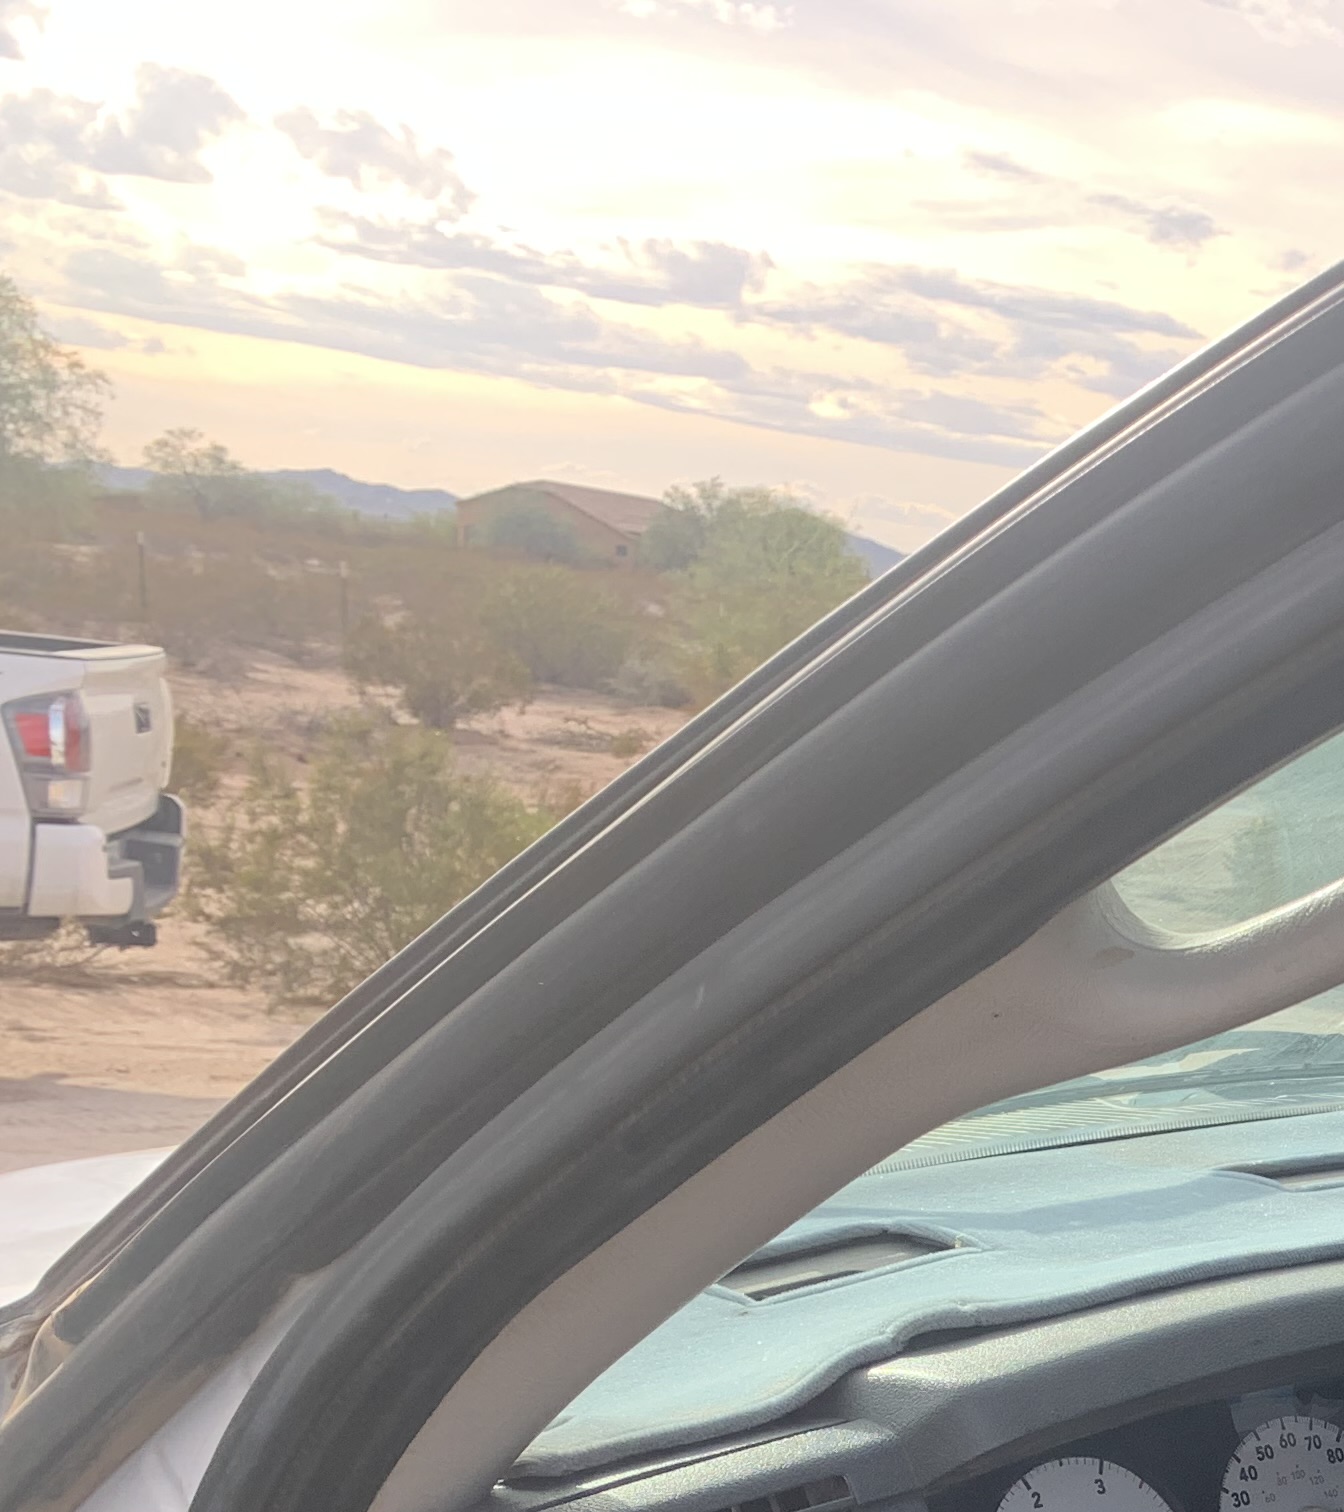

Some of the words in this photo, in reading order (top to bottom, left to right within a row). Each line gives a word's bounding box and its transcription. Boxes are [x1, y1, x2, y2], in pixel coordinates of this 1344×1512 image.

[1279, 1432, 1297, 1449] 60
[1304, 1434, 1322, 1451] 70
[1255, 1444, 1275, 1461] 50
[1326, 1447, 1344, 1464] 80
[1239, 1465, 1258, 1482] 40
[1093, 1478, 1106, 1495] 3
[1030, 1491, 1044, 1509] 2
[1231, 1490, 1250, 1508] 30
